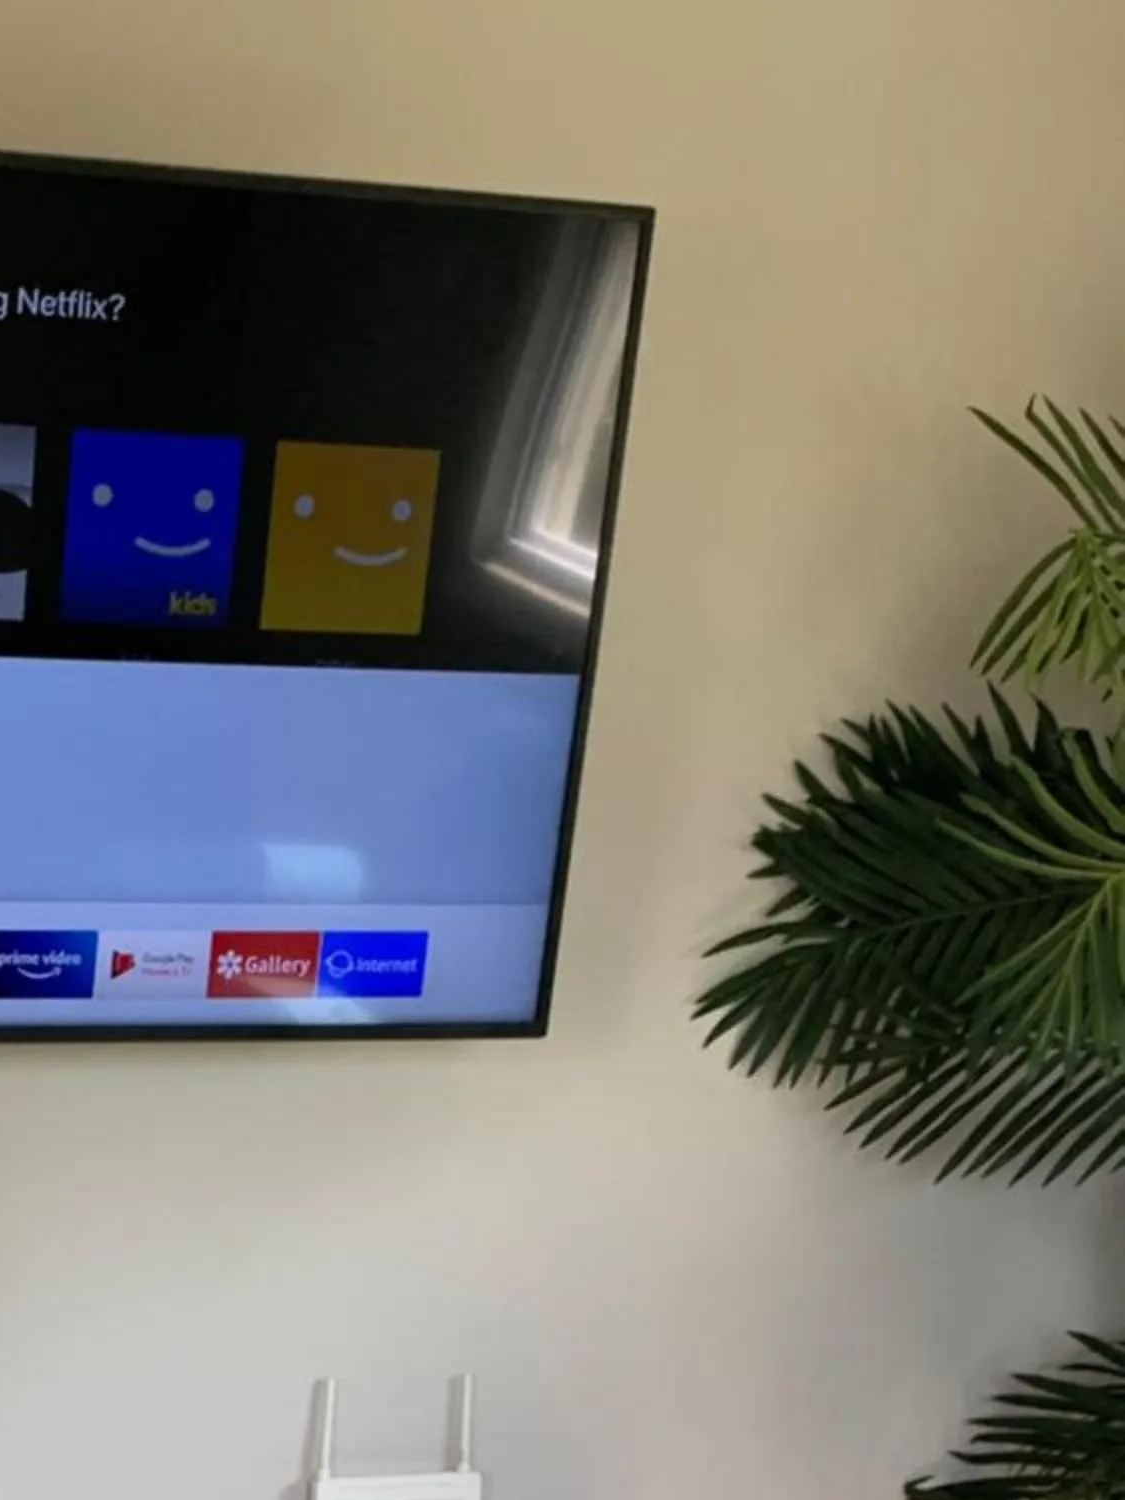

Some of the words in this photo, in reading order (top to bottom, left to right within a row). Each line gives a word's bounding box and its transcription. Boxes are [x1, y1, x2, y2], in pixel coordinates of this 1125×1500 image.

[16, 288, 126, 321] Netflix?
[169, 591, 217, 616] kids
[42, 949, 83, 966] video
[245, 954, 312, 977] Gallery
[356, 958, 419, 974] Internet
